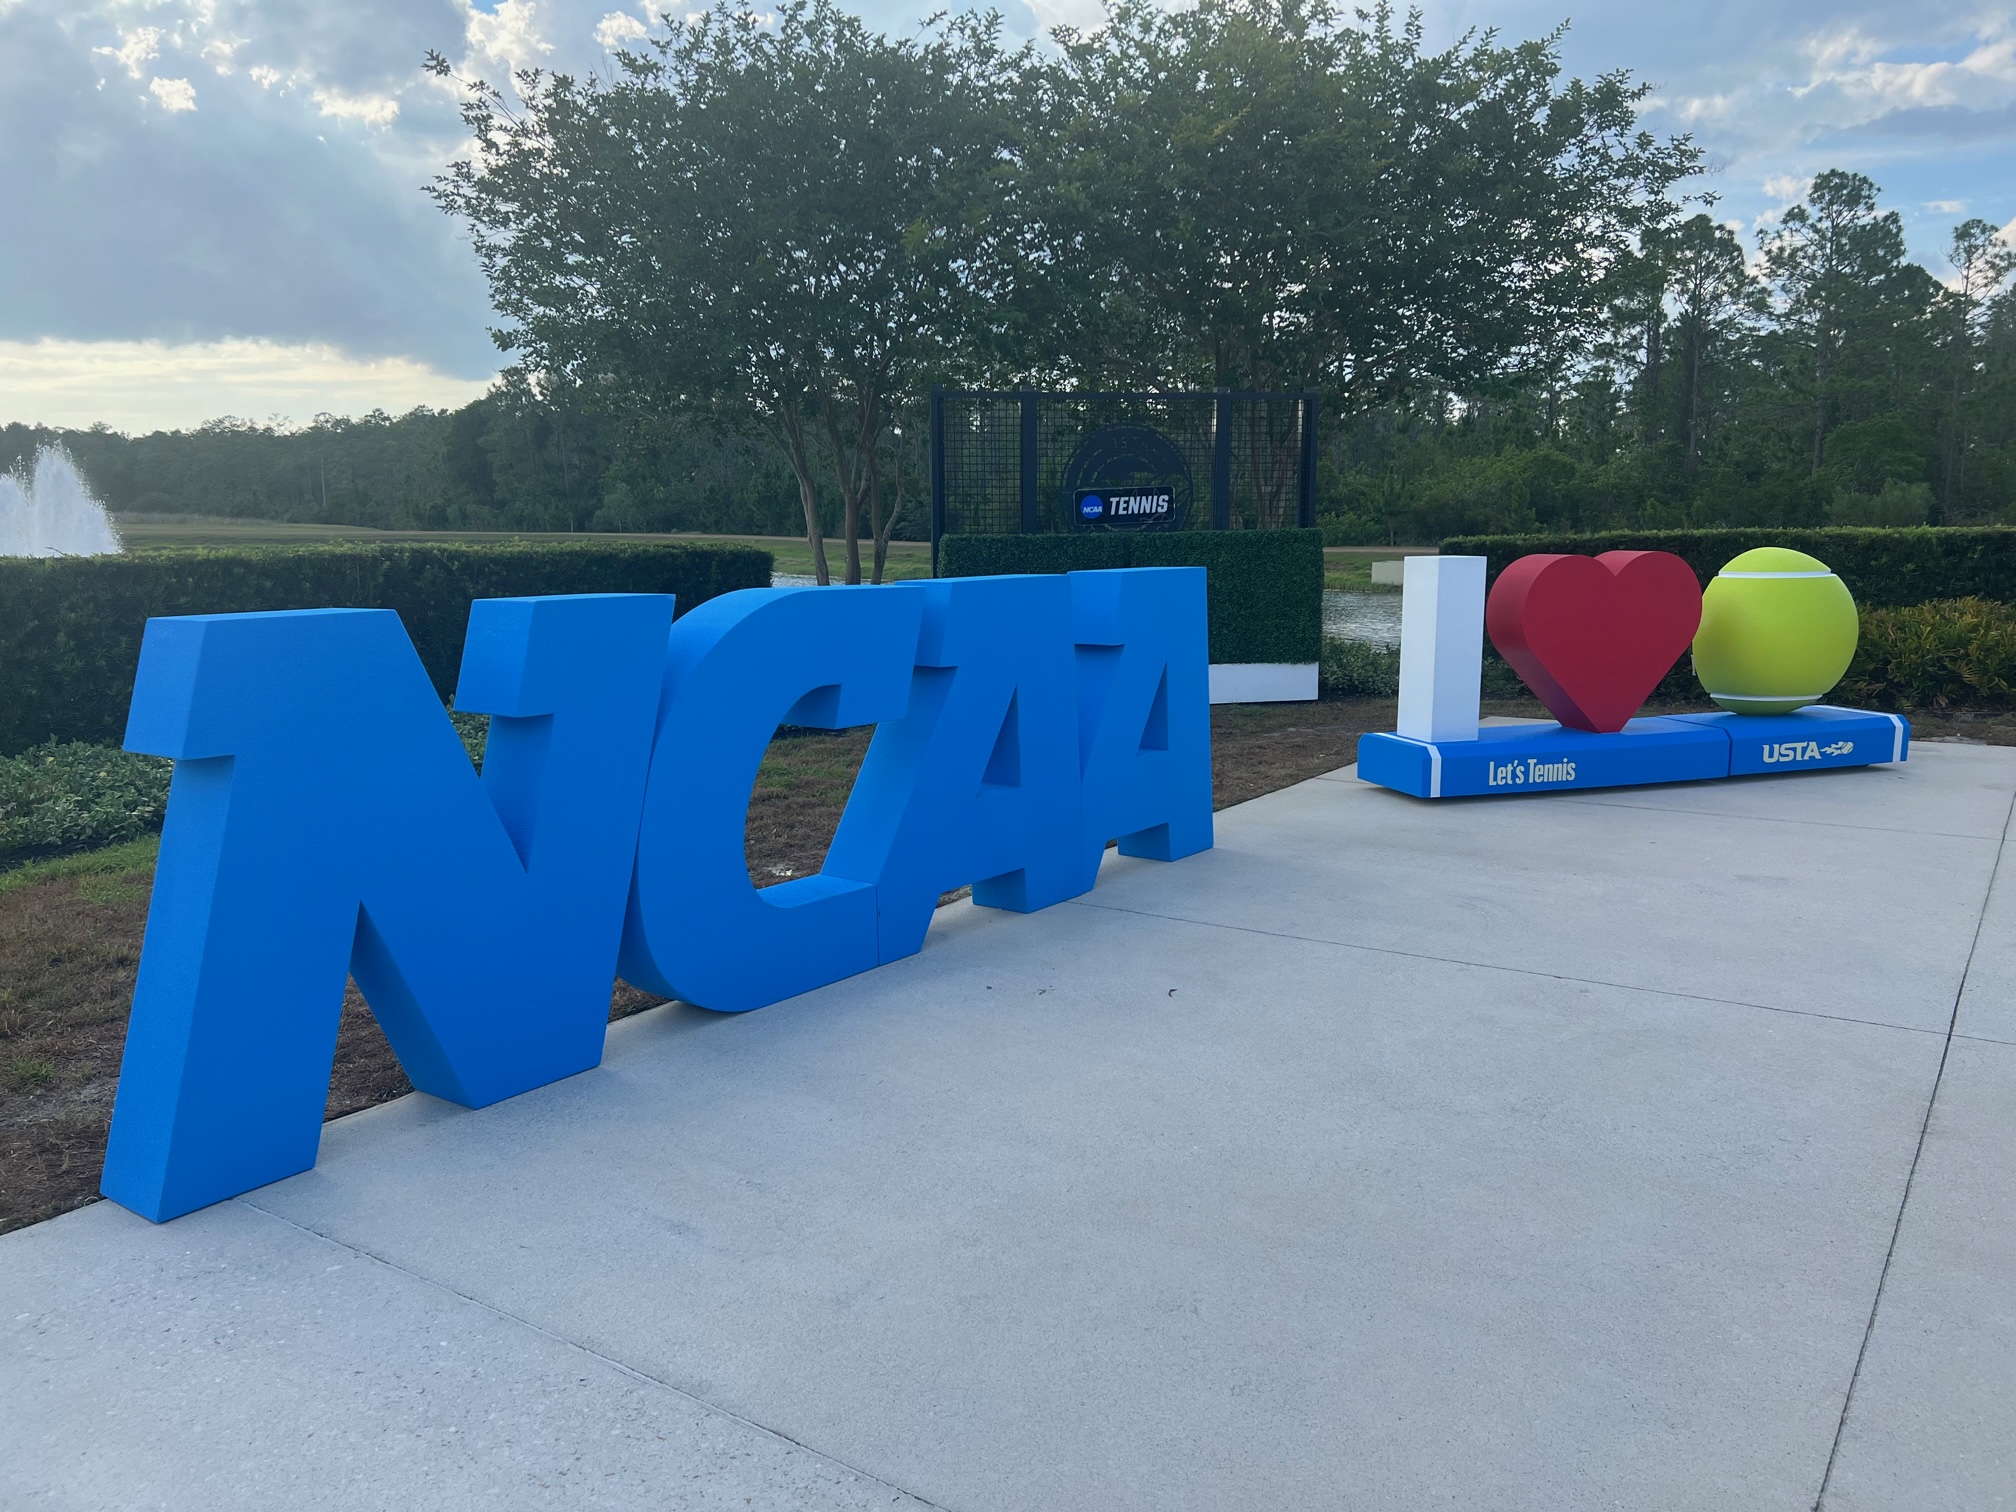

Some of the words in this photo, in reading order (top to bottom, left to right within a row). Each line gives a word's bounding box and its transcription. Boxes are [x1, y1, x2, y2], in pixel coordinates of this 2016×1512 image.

[1082, 506, 1103, 514] NCAA
[1109, 494, 1169, 516] TENNIS
[1762, 741, 1822, 763] USTA
[1488, 760, 1525, 786] Let's
[1527, 757, 1576, 784] Tennis
[101, 565, 1214, 1224] NCAA
